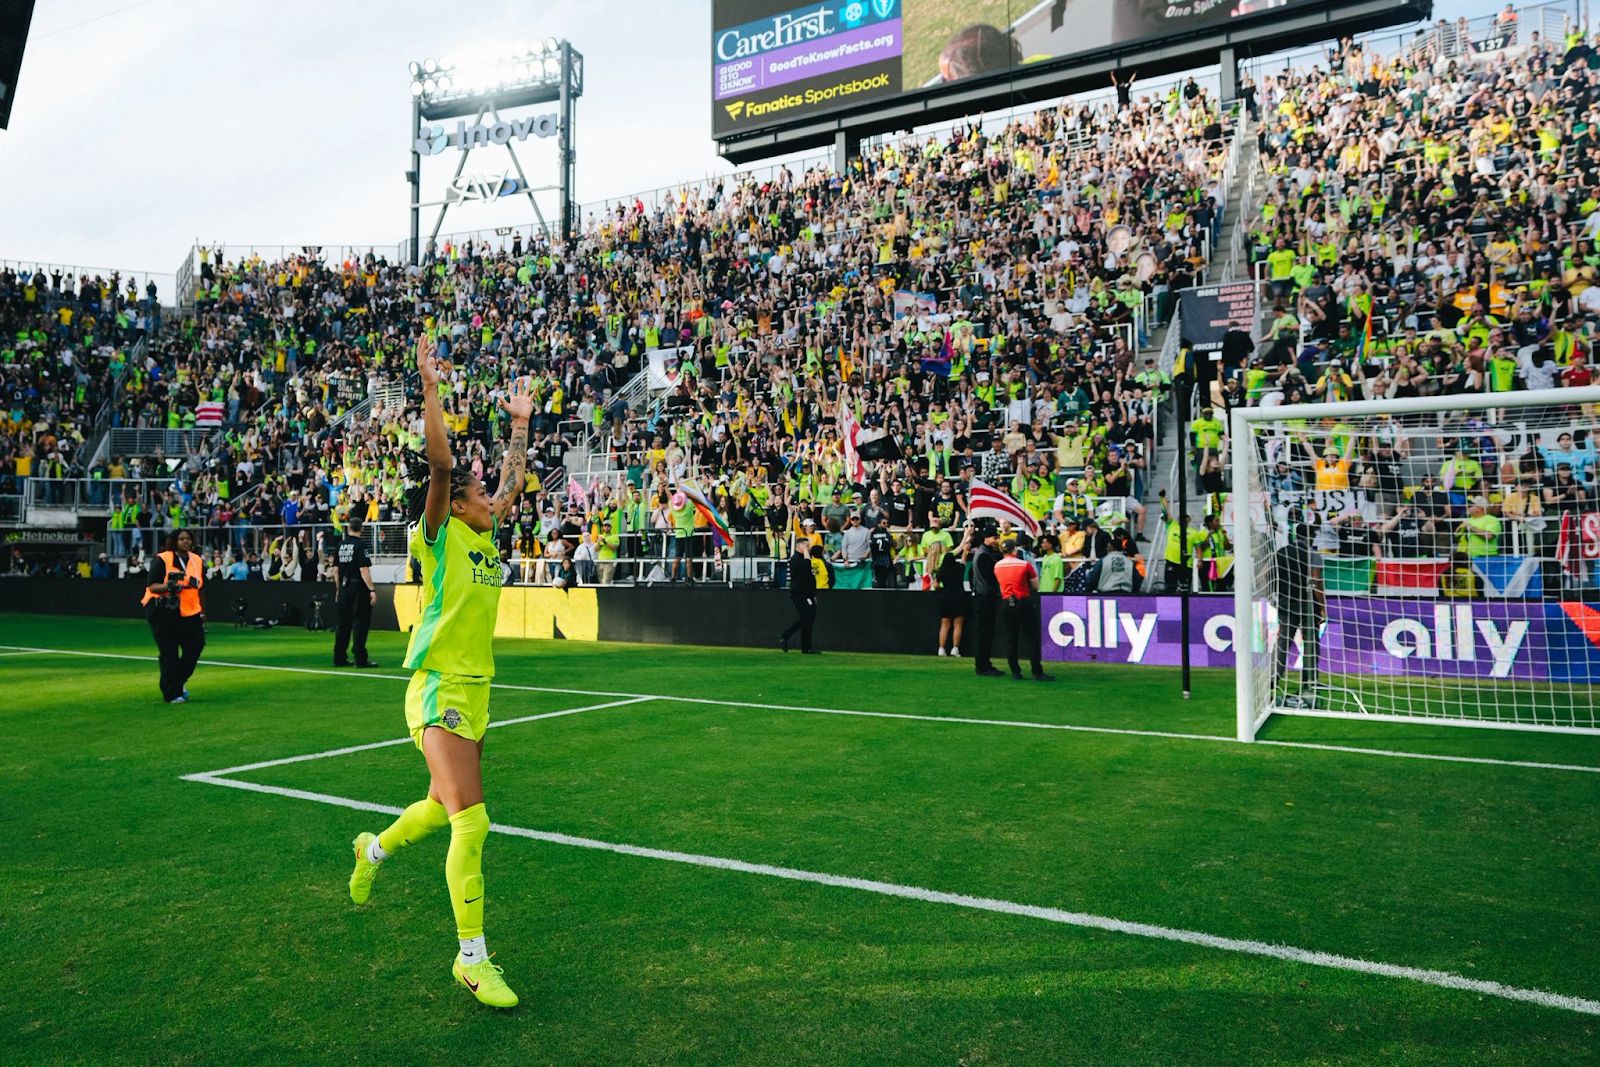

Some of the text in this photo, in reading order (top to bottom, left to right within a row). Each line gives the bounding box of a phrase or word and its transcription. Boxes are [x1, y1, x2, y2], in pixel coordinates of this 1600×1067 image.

[1165, 5, 1191, 17] One
[769, 34, 894, 73] GoodToKnowFacts.org
[1479, 37, 1504, 51] 137
[728, 61, 753, 73] GOOD
[728, 72, 739, 81] TO
[746, 73, 889, 118] Fanatics Sportsbook
[456, 113, 558, 151] Inova
[22, 531, 79, 541] Heineken
[1048, 599, 1158, 663] ally
[1382, 603, 1530, 678] ally
